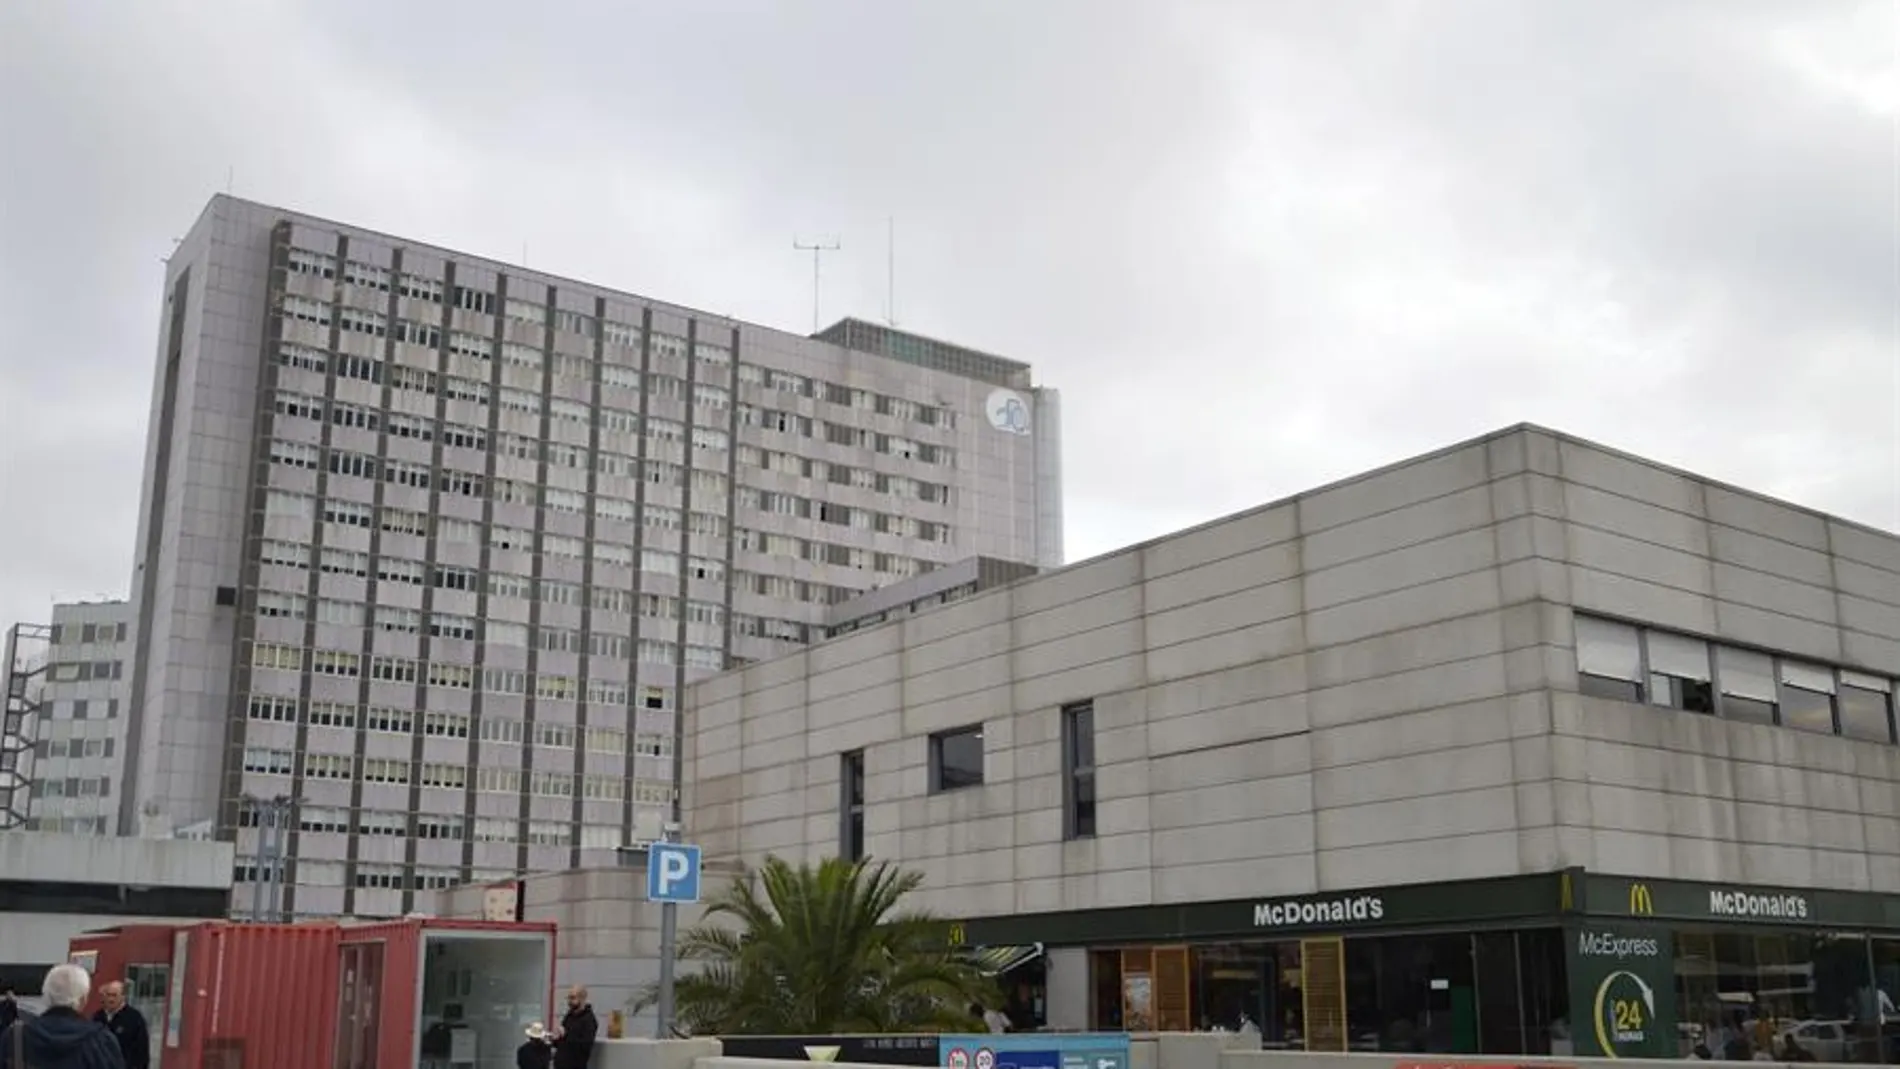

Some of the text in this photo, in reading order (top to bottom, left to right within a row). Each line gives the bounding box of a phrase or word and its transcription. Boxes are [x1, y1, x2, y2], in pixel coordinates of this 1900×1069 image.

[659, 851, 689, 895] P
[1253, 896, 1384, 926] McDonald's
[1709, 891, 1808, 918] McDonald's
[1579, 931, 1658, 960] McExpress
[1616, 1000, 1643, 1030] 24
